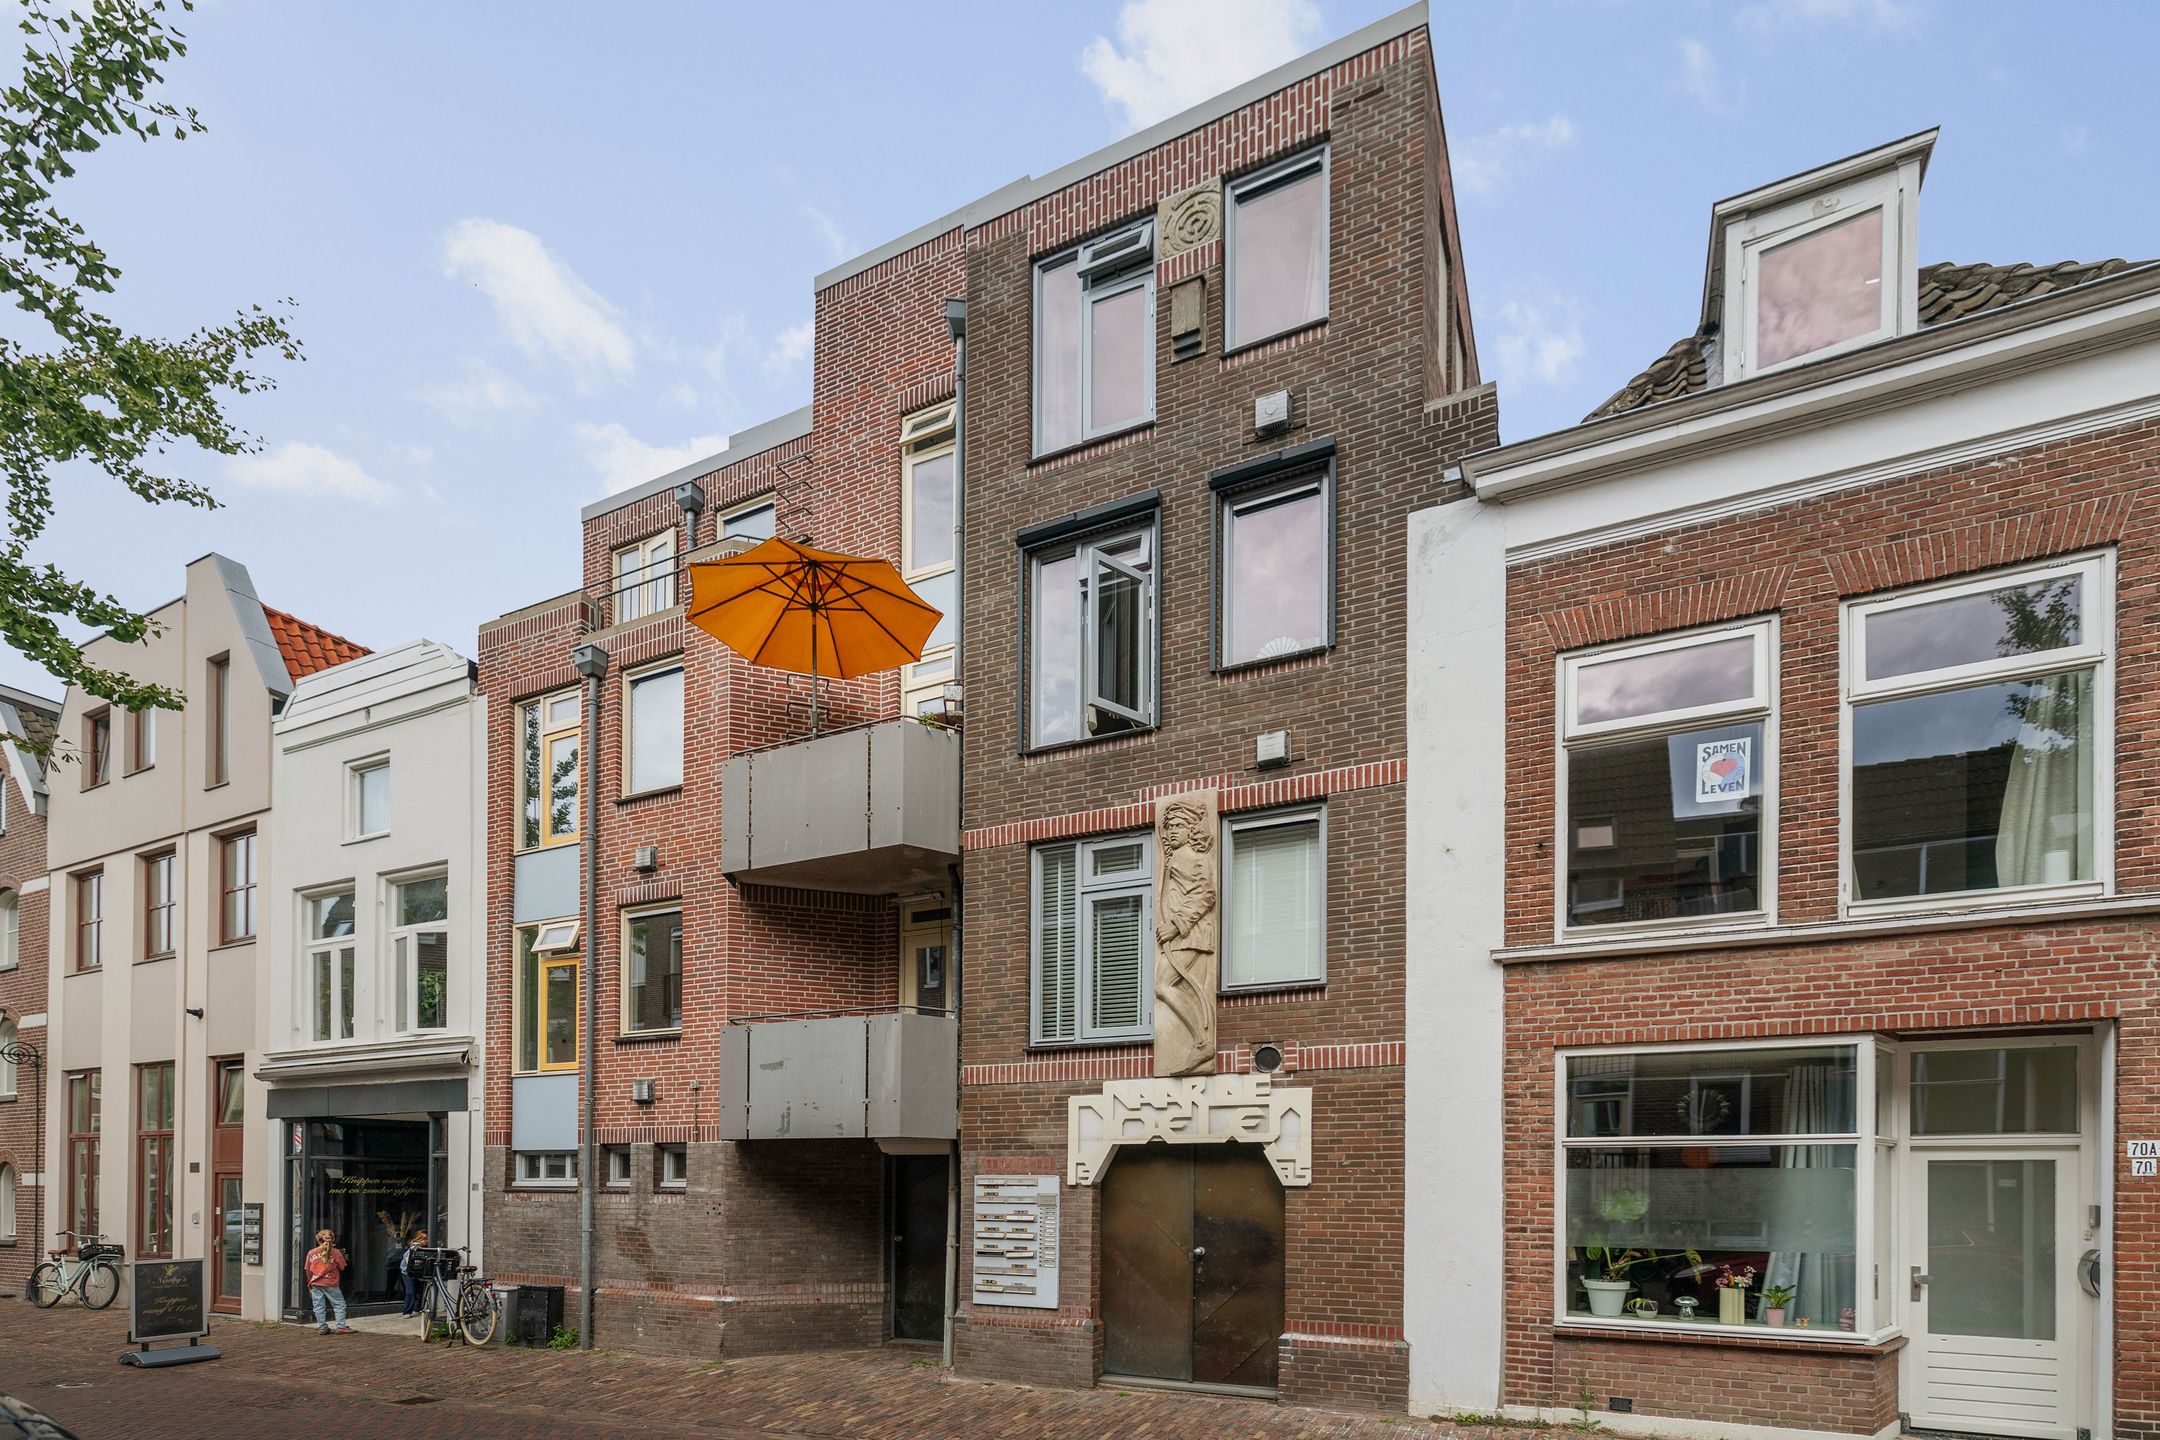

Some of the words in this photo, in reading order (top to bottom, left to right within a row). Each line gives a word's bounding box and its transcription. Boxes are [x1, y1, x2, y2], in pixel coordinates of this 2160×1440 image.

[1702, 741, 1746, 763] SAMEN
[1701, 774, 1745, 795] LEVEN
[2131, 1142, 2157, 1156] 70A
[2135, 1160, 2153, 1174] 70
[340, 1176, 380, 1186] Knippen
[362, 1186, 393, 1194] zonder
